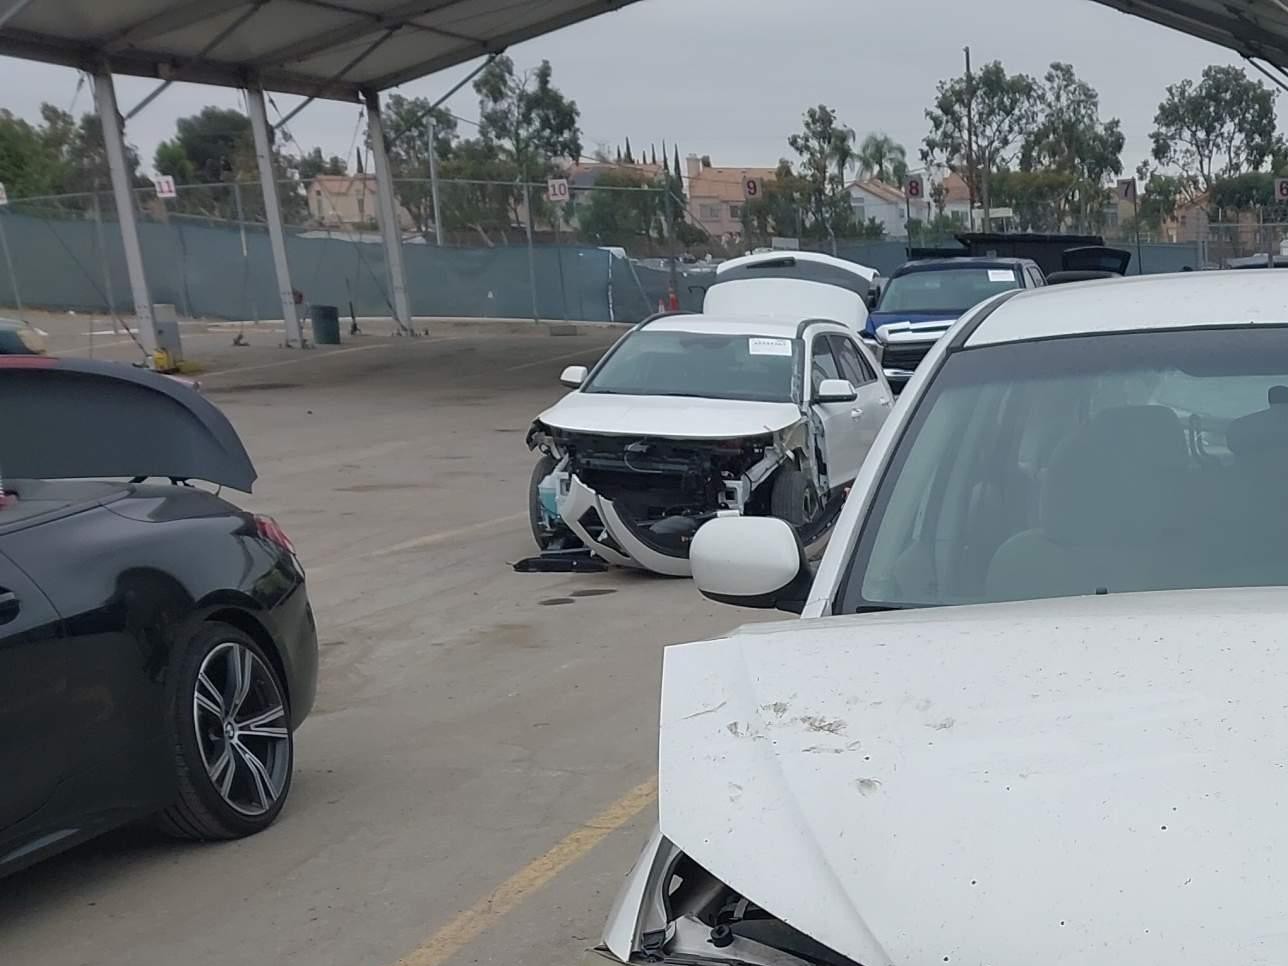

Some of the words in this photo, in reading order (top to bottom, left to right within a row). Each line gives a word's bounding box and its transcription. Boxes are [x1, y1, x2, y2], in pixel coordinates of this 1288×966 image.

[157, 181, 173, 194] 11
[550, 184, 567, 196] 10
[746, 180, 757, 196] 9
[908, 180, 919, 196] 8
[1121, 182, 1131, 198] 7
[1279, 181, 1288, 197] 6
